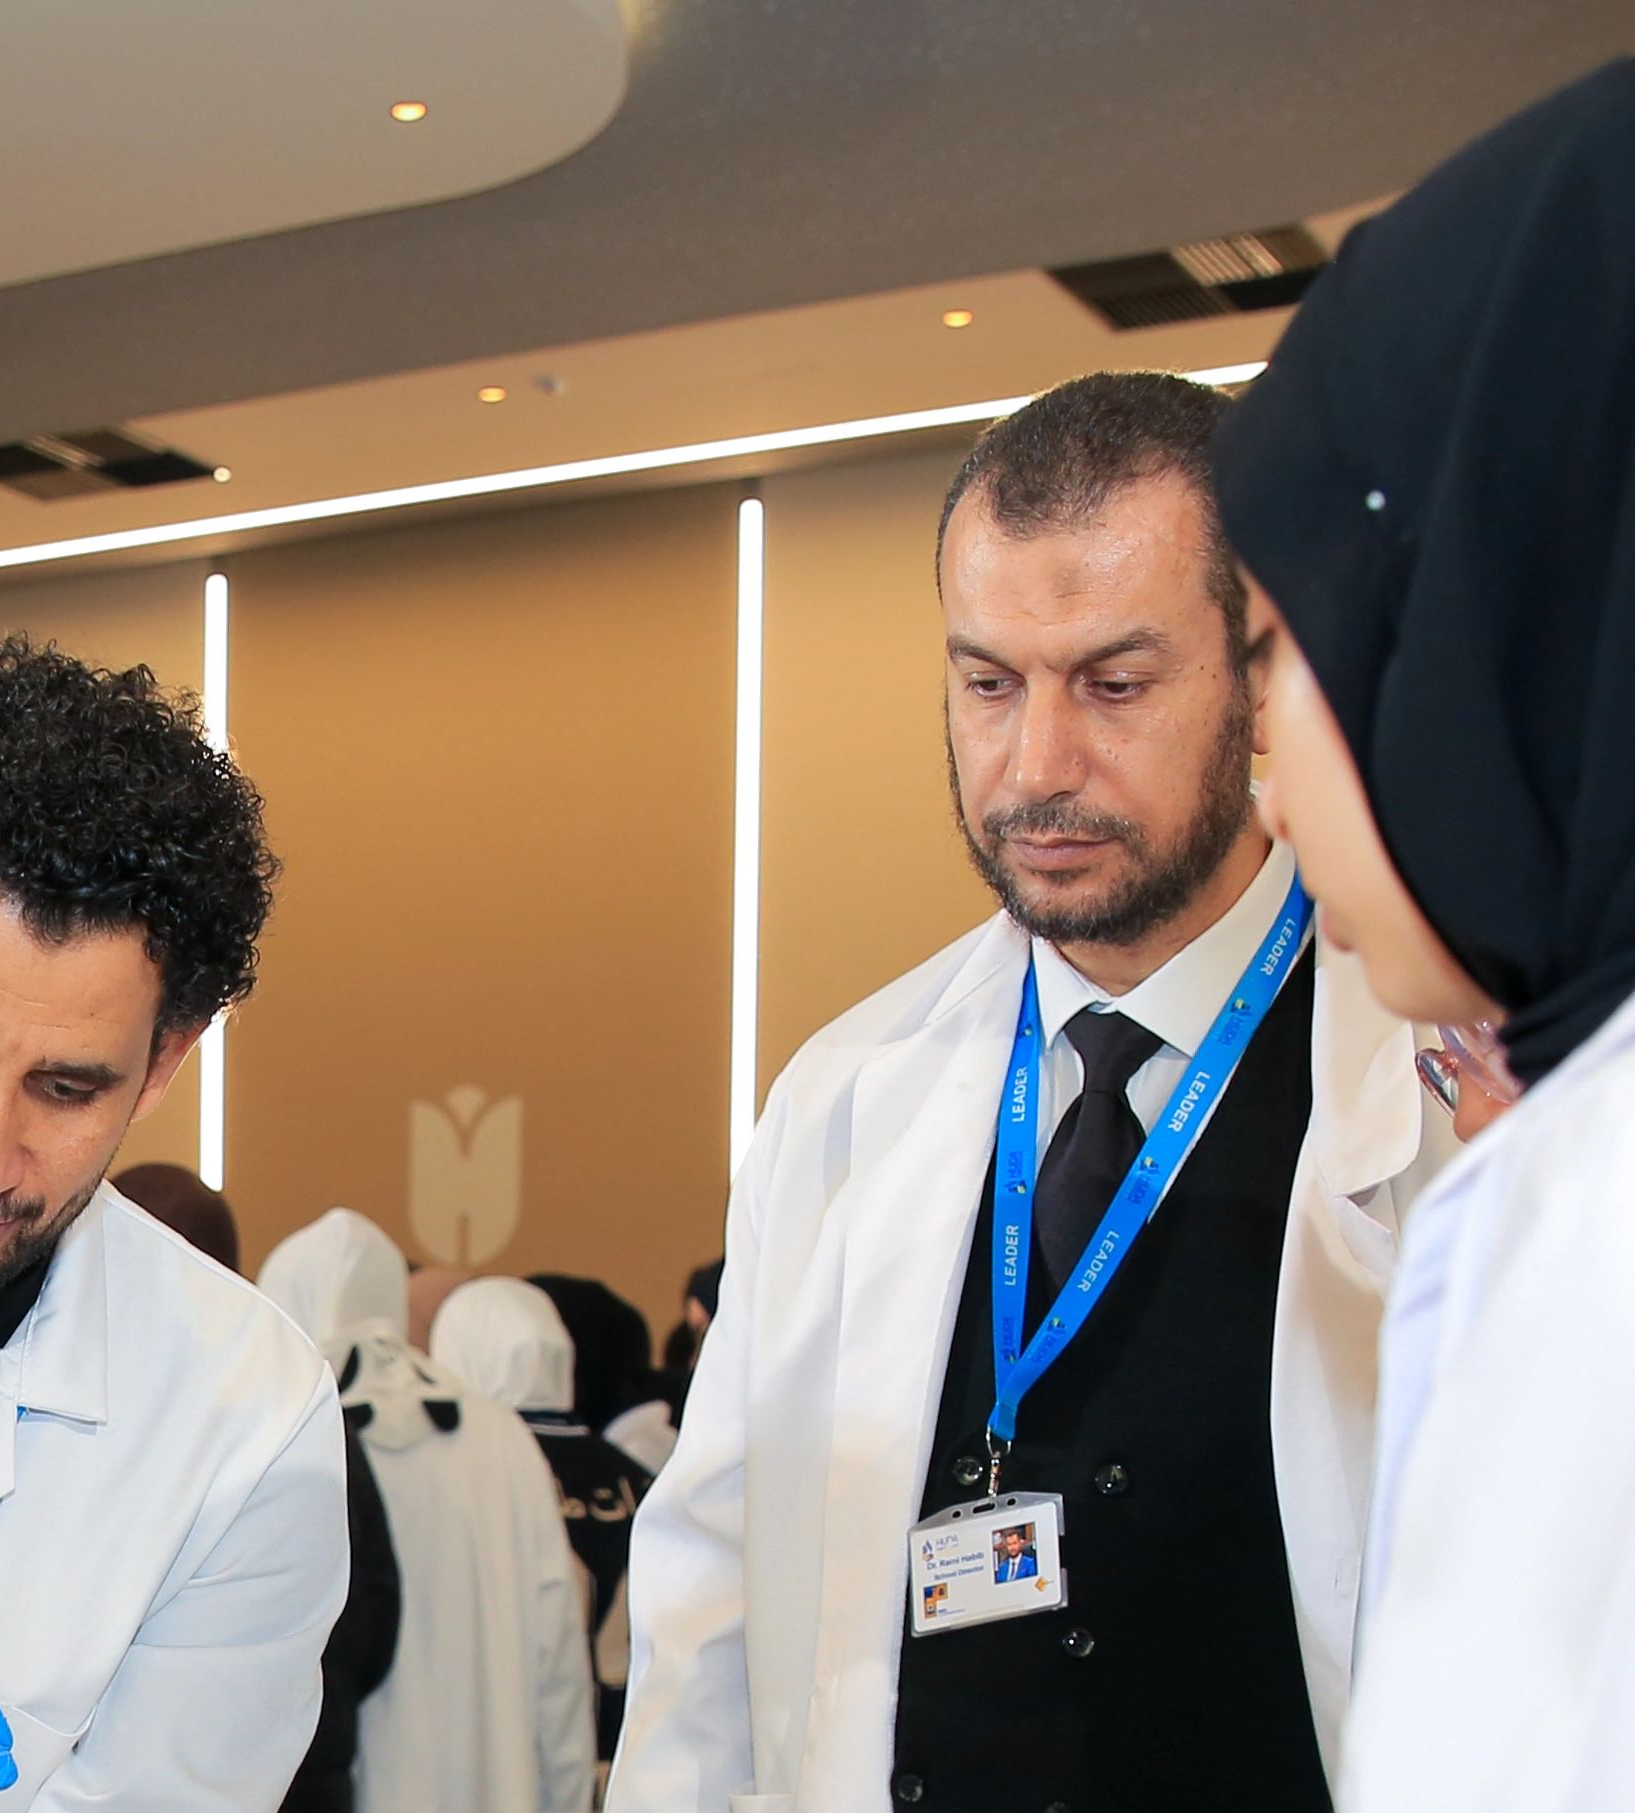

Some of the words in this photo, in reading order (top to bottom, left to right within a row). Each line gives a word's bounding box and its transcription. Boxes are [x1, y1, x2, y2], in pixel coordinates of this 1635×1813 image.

[1259, 918, 1296, 975] LEADER
[1012, 1066, 1028, 1123] LEADER
[1168, 1071, 1211, 1133] LEADER
[1004, 1225, 1019, 1286] LEADER
[1077, 1230, 1120, 1292] LEADER
